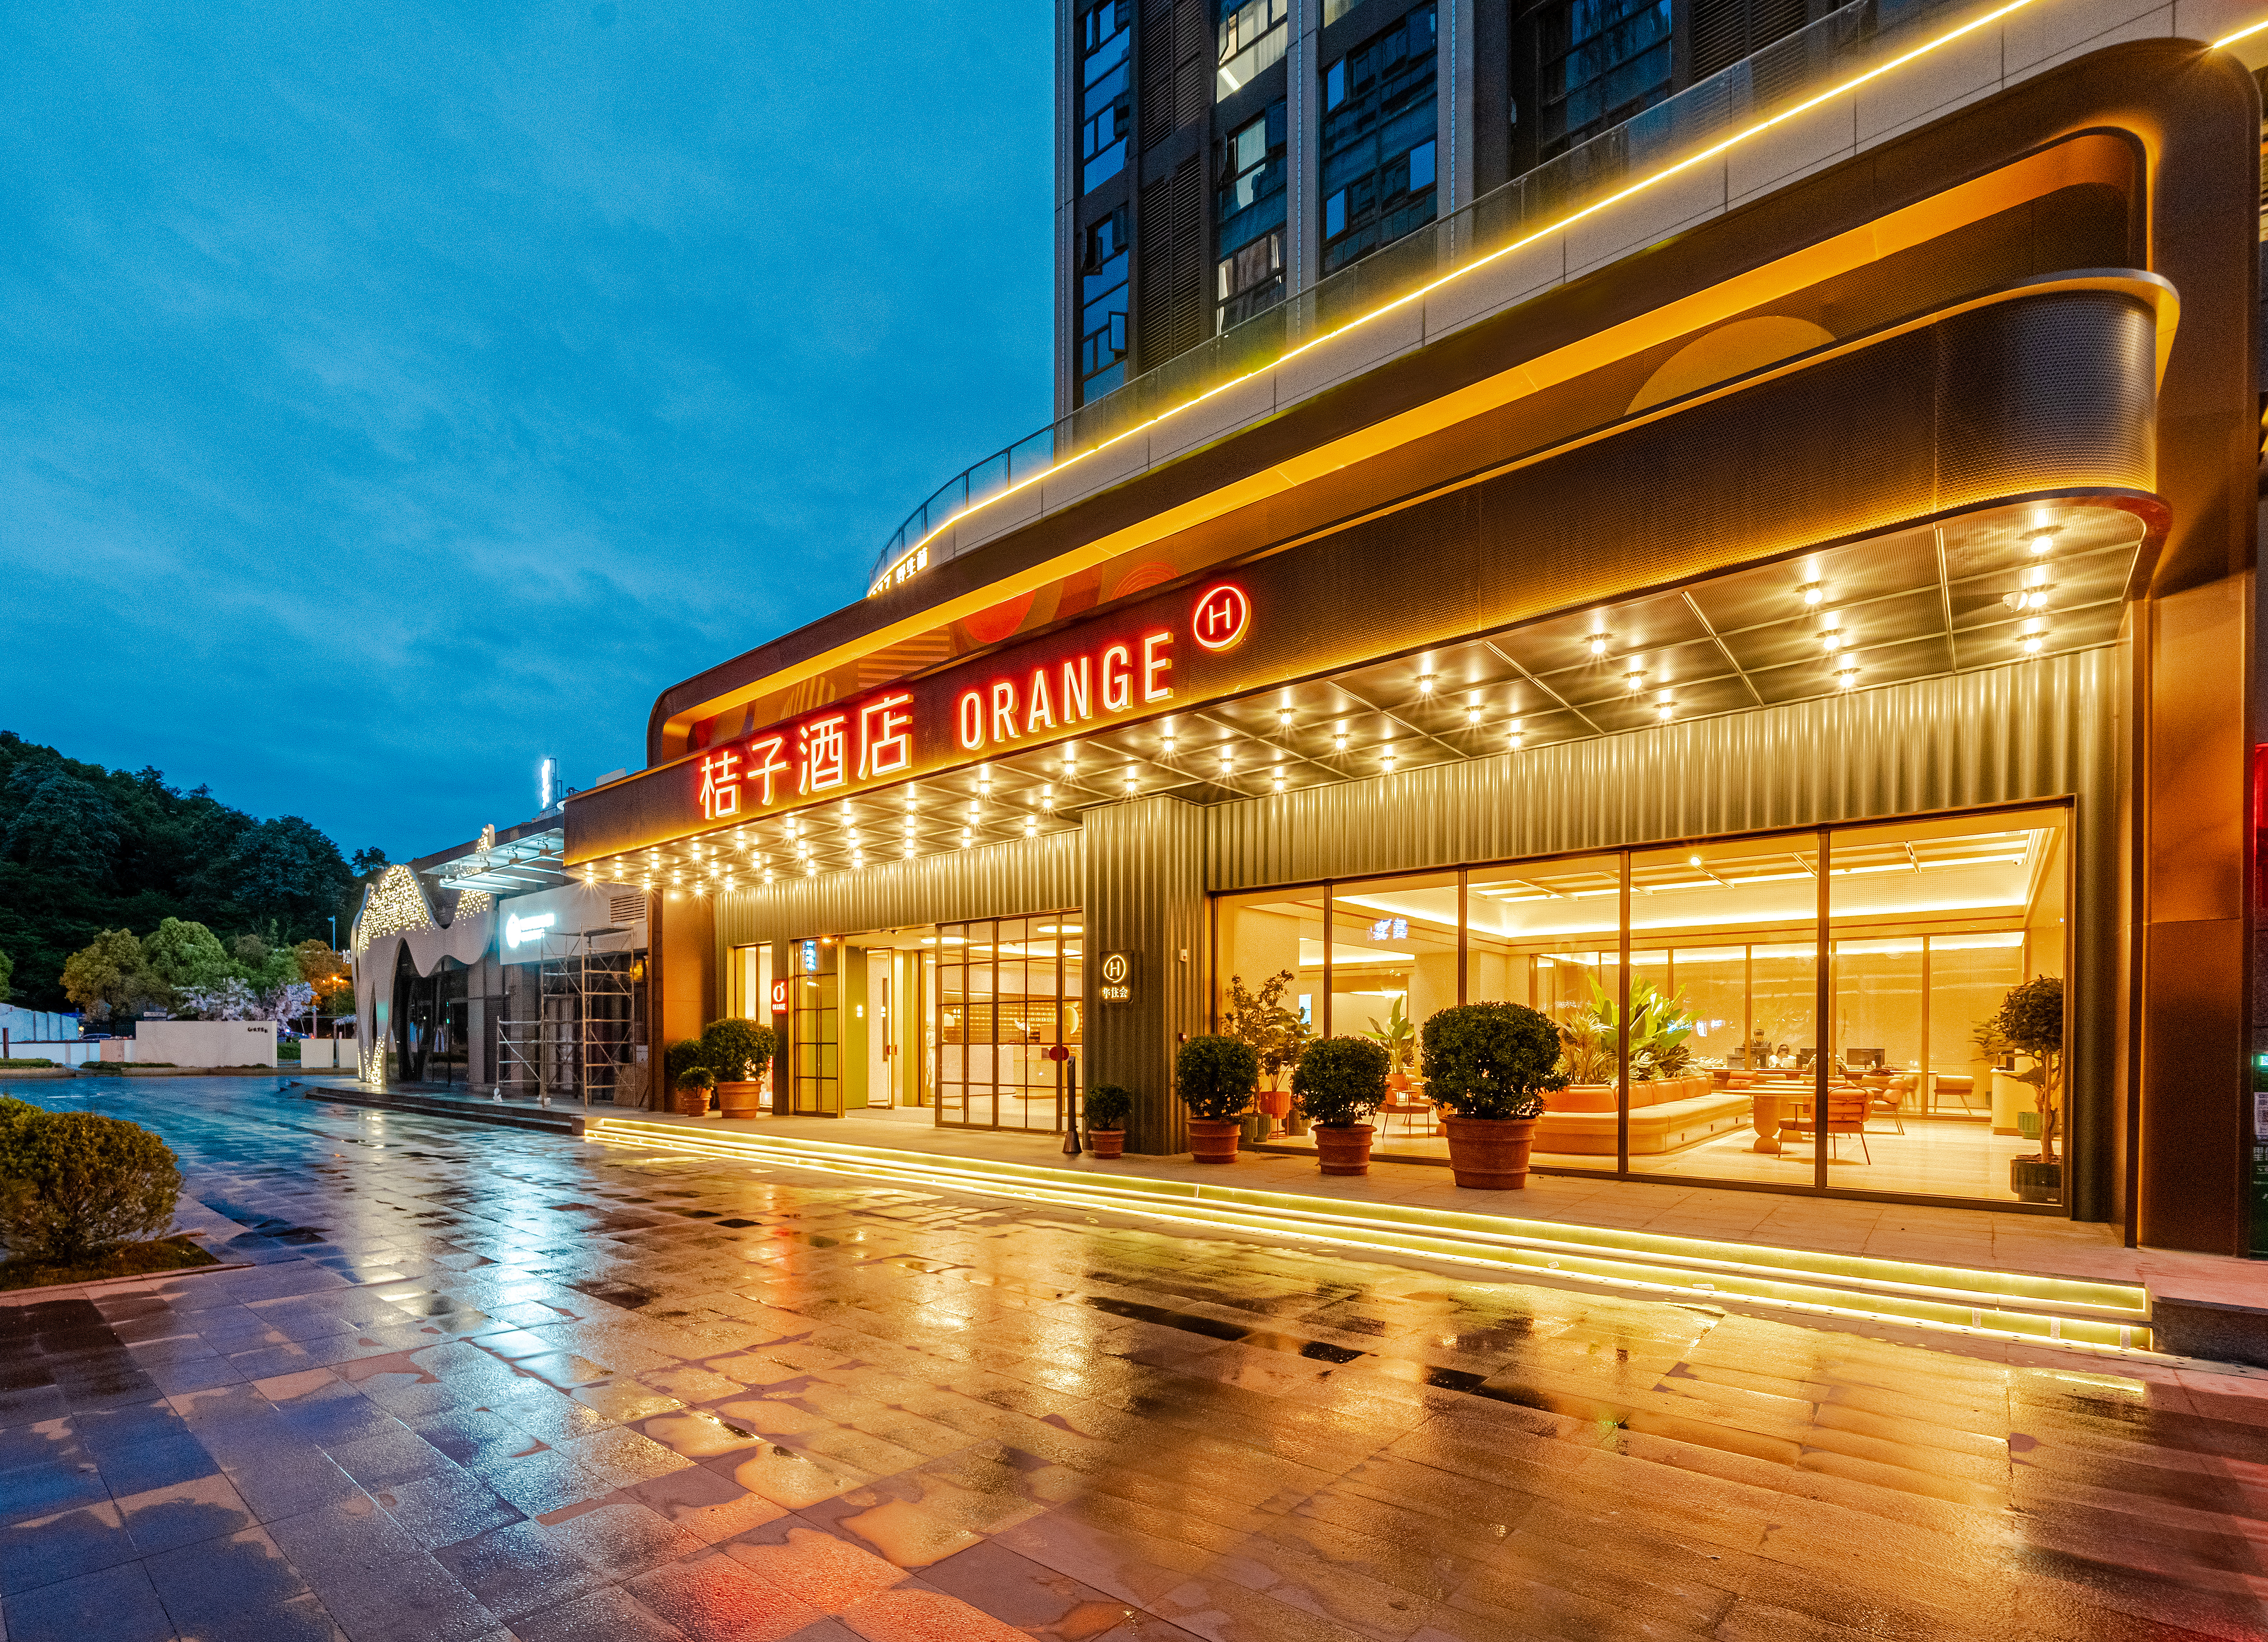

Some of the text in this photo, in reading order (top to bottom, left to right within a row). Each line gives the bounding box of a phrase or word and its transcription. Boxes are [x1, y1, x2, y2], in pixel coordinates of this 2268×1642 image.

[699, 694, 913, 820] 桔子酒店
[961, 632, 1173, 750] ORANGE
[1102, 987, 1128, 999] 华住会
